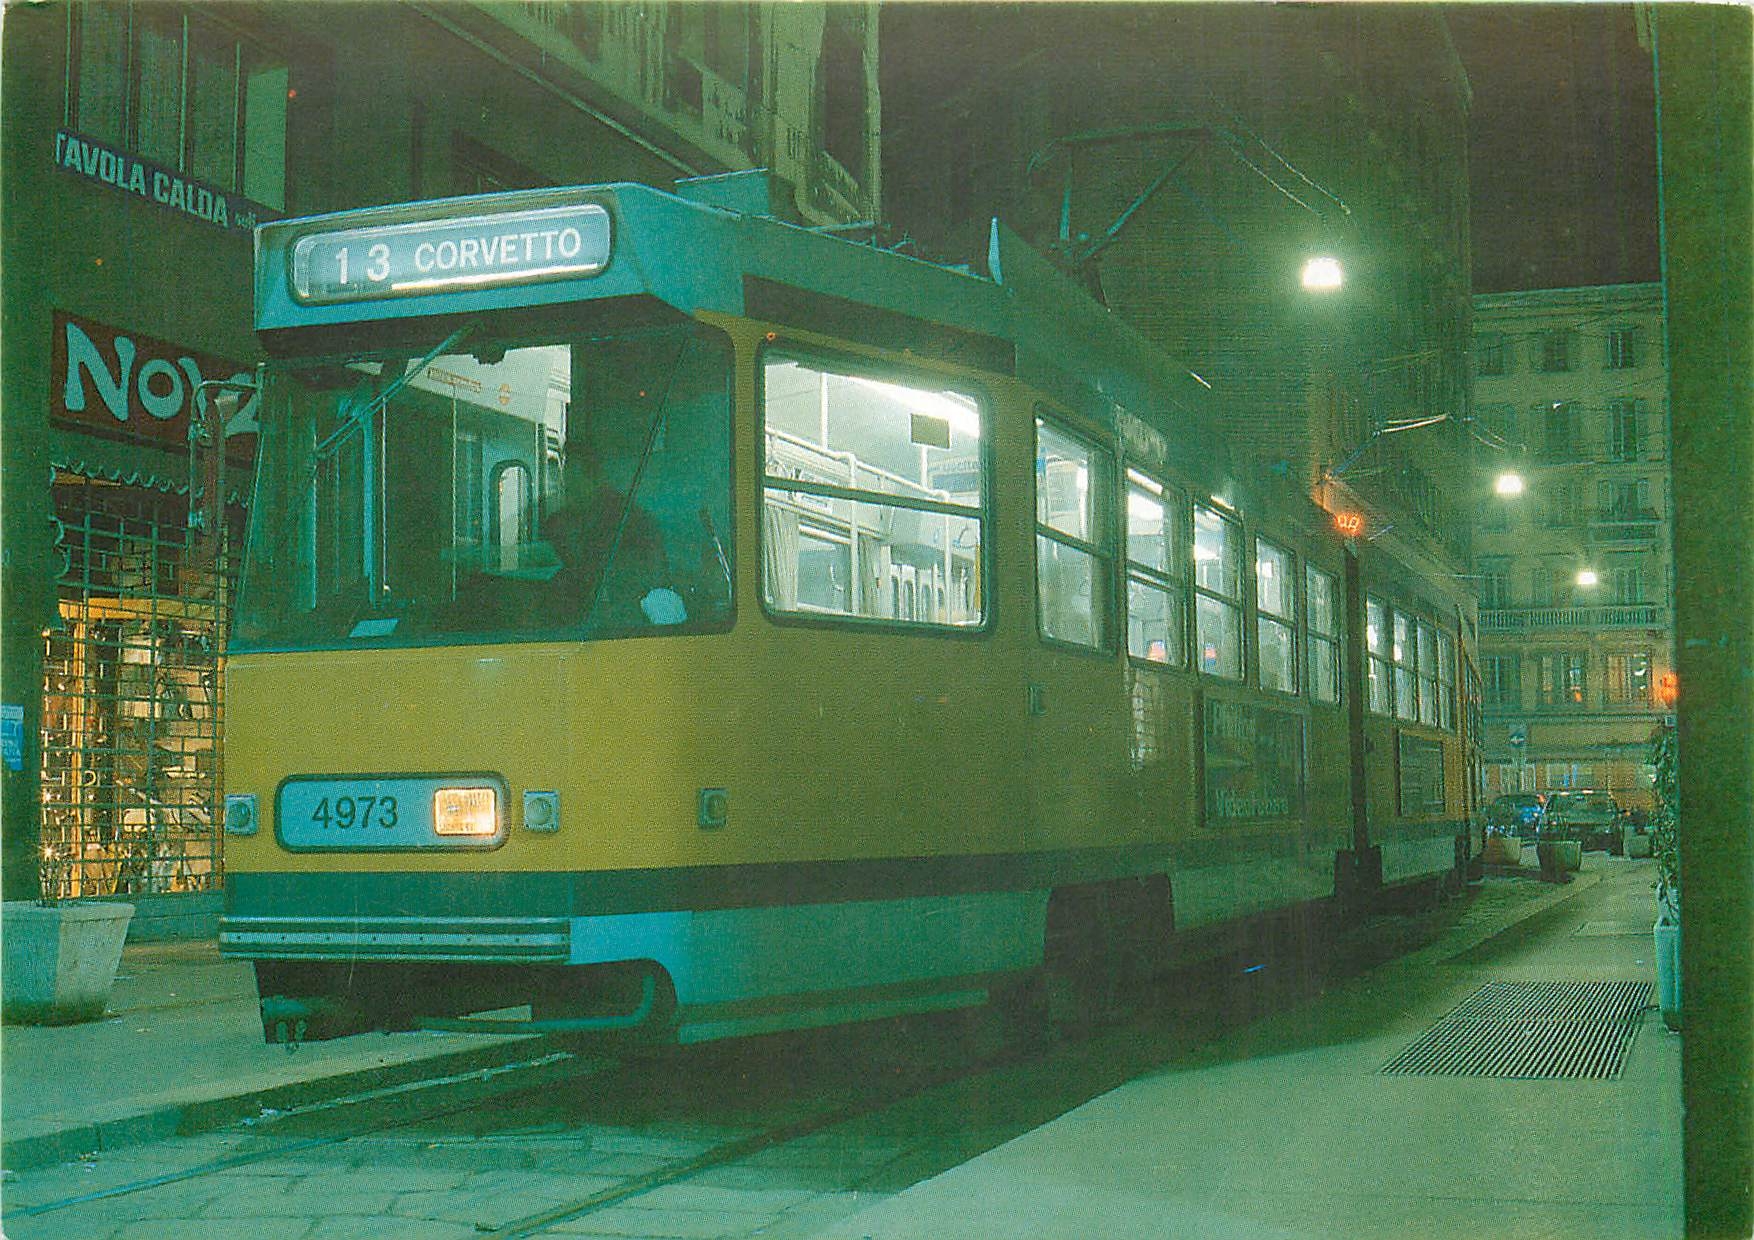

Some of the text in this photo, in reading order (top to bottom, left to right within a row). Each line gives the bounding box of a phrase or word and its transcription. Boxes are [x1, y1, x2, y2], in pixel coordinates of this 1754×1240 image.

[55, 132, 229, 228] TAVOLA CALDA
[414, 227, 582, 273] CORVETTO
[311, 796, 399, 830] 4973
